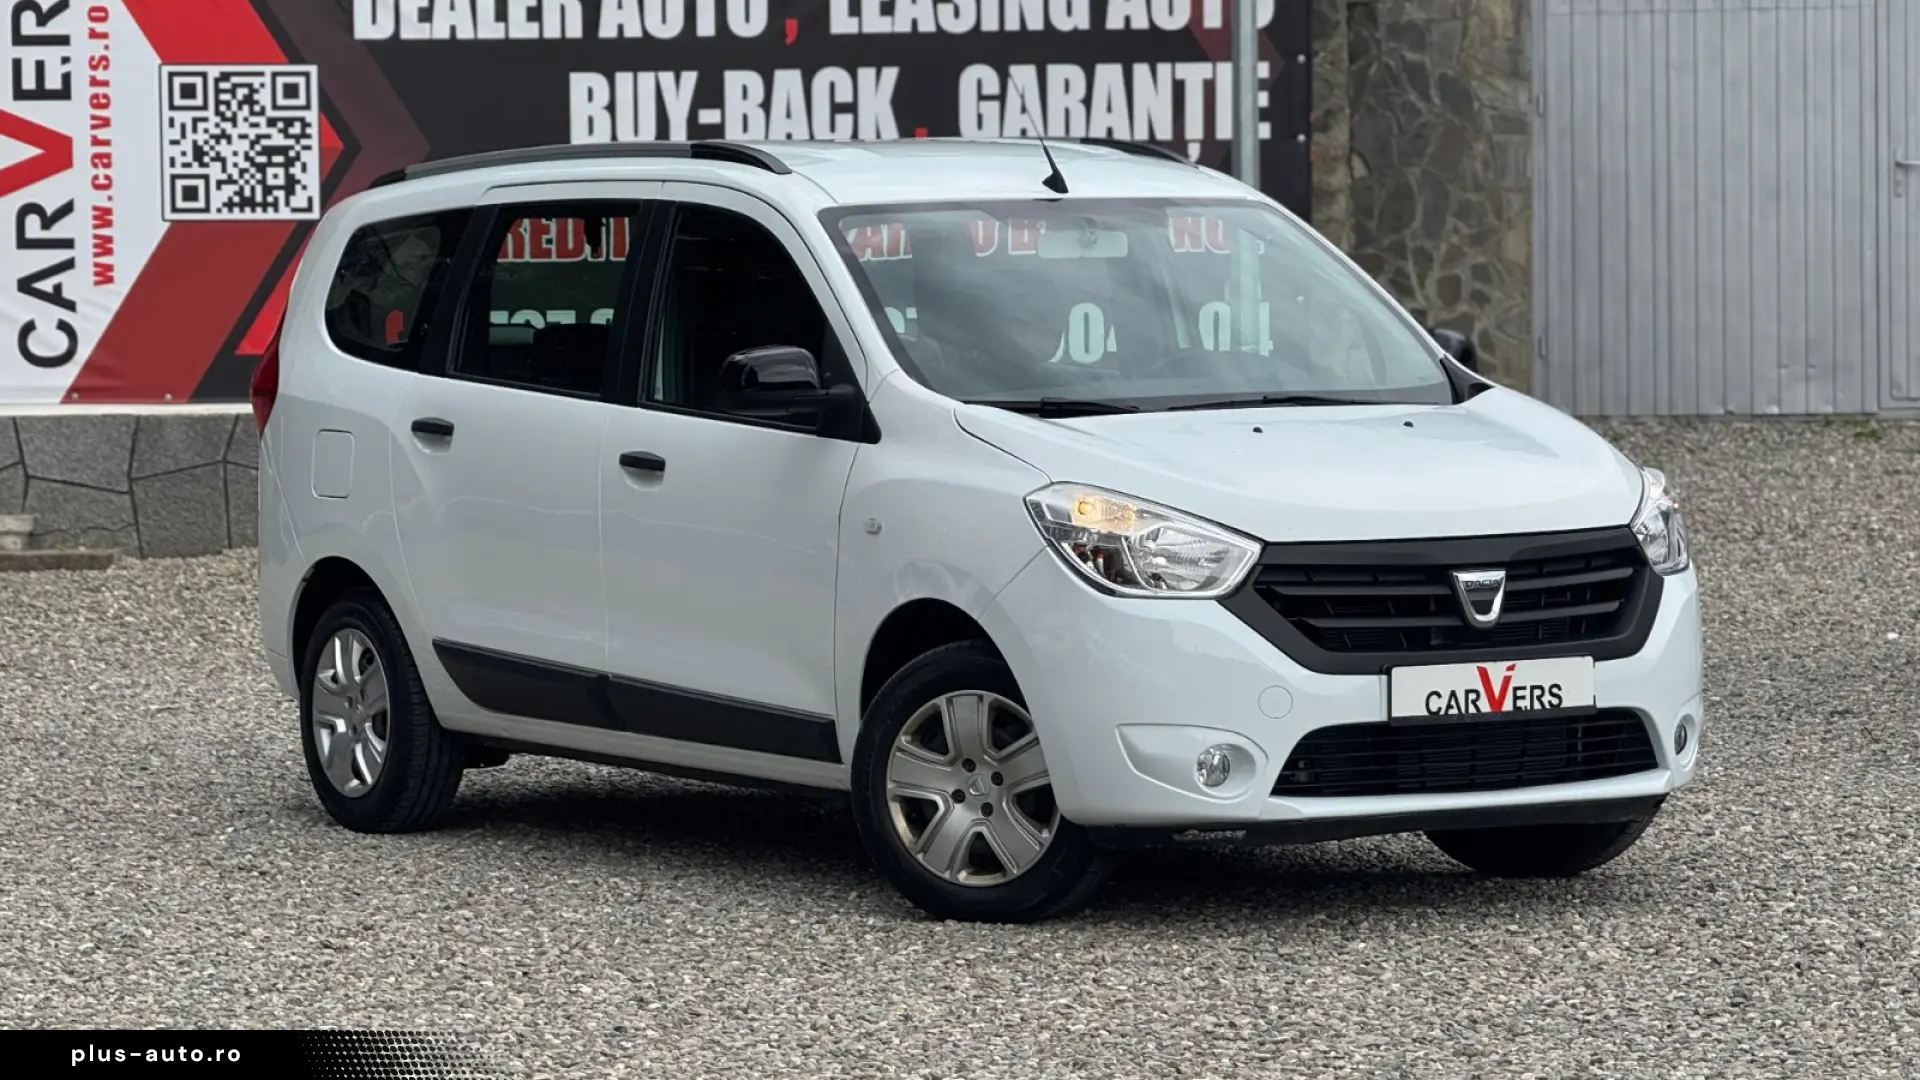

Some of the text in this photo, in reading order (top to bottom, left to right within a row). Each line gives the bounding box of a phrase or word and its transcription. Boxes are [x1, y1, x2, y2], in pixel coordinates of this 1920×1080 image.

[569, 65, 901, 144] BUY-BACK
[87, 5, 115, 287] www.carvers.ro
[1424, 663, 1564, 716] CARVERS
